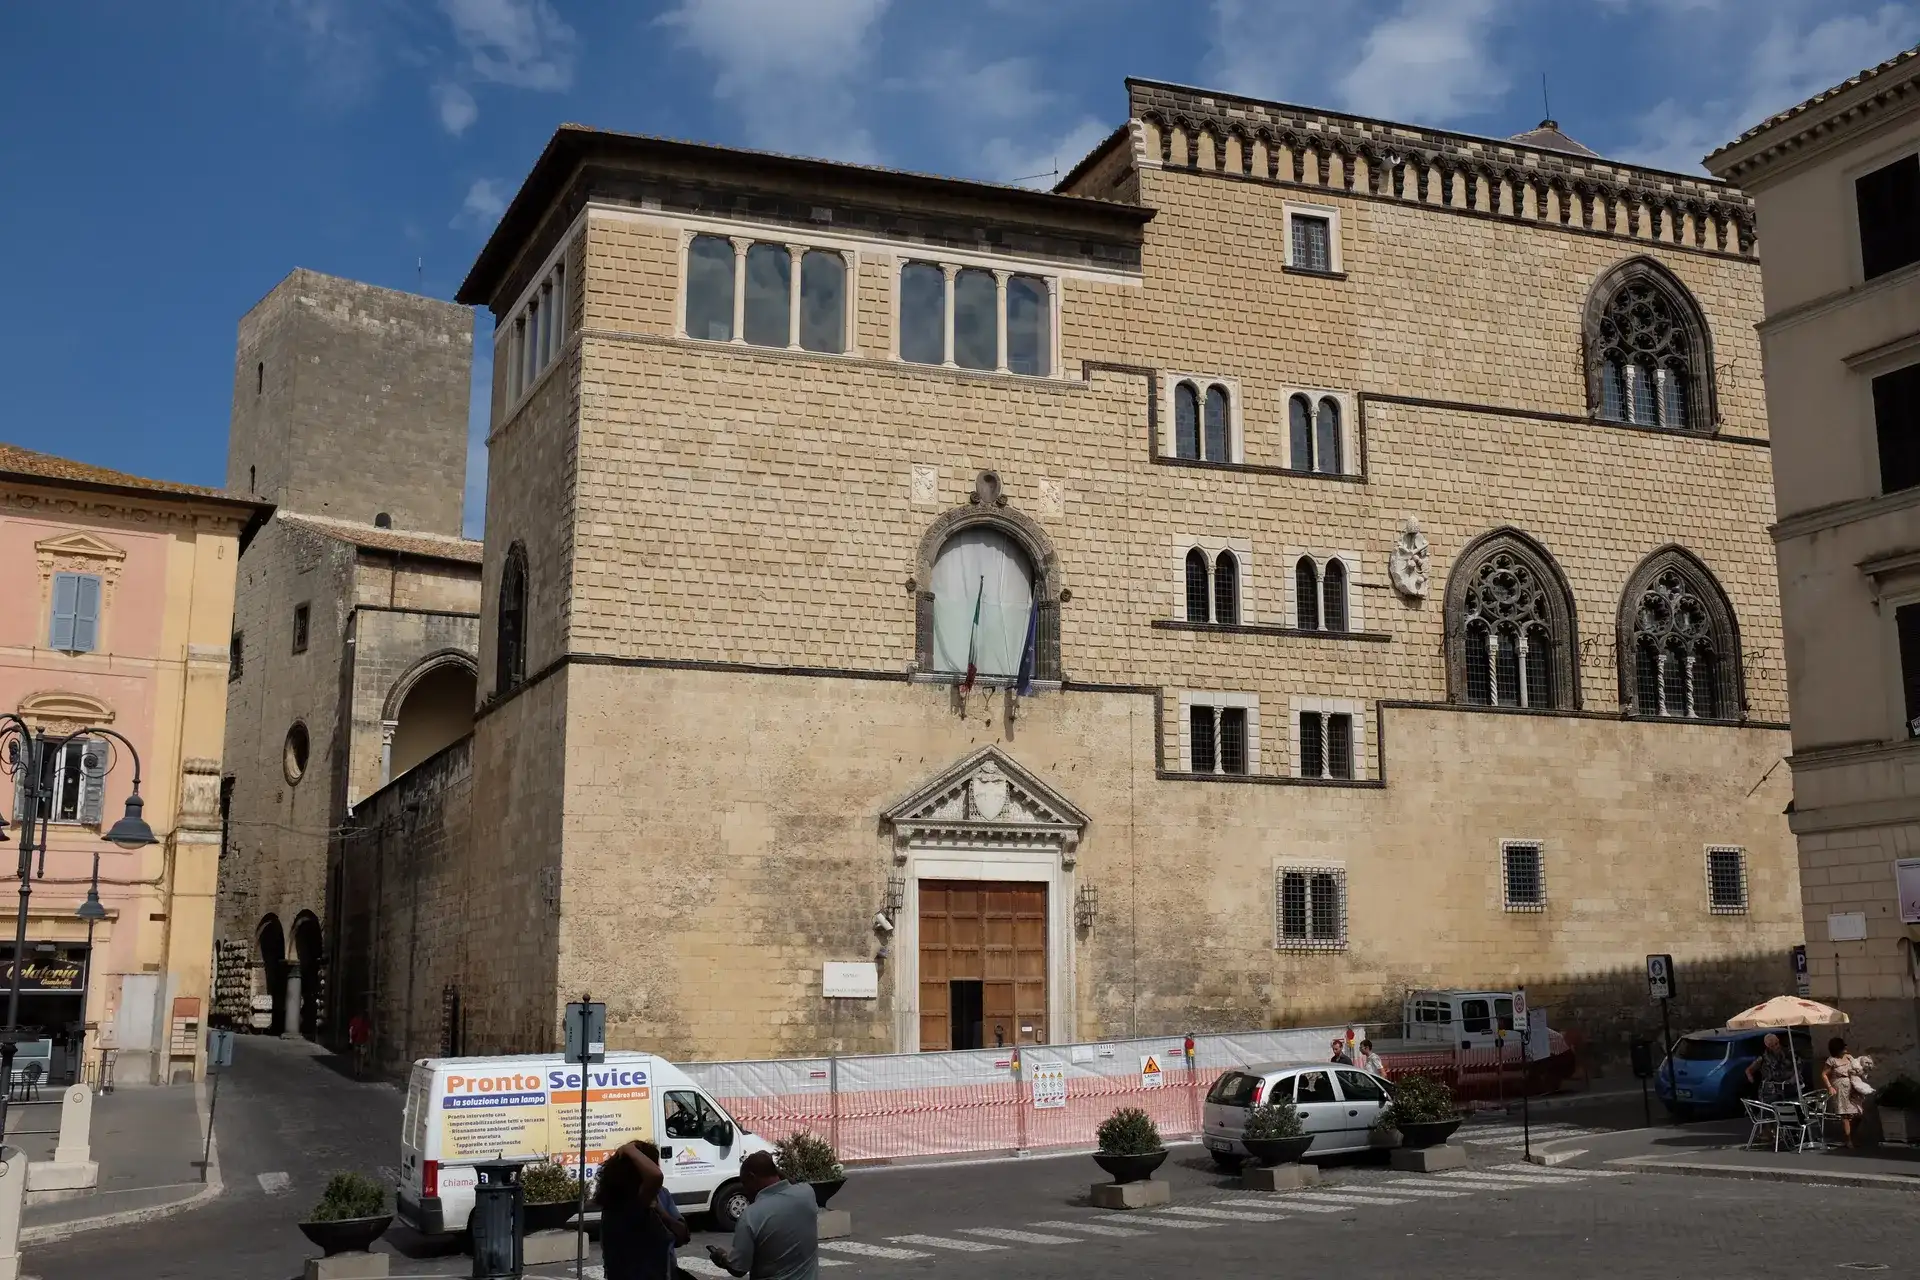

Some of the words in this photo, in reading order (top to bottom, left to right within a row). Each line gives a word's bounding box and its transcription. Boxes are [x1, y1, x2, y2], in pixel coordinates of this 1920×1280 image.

[447, 1073, 541, 1094] Pronto
[548, 1068, 647, 1089] Service
[608, 1091, 630, 1099] Andrea
[453, 1098, 461, 1106] la
[462, 1097, 499, 1106] soluzione
[500, 1096, 508, 1104] in
[520, 1095, 545, 1105] lampo
[443, 1177, 477, 1187] Chiama:
